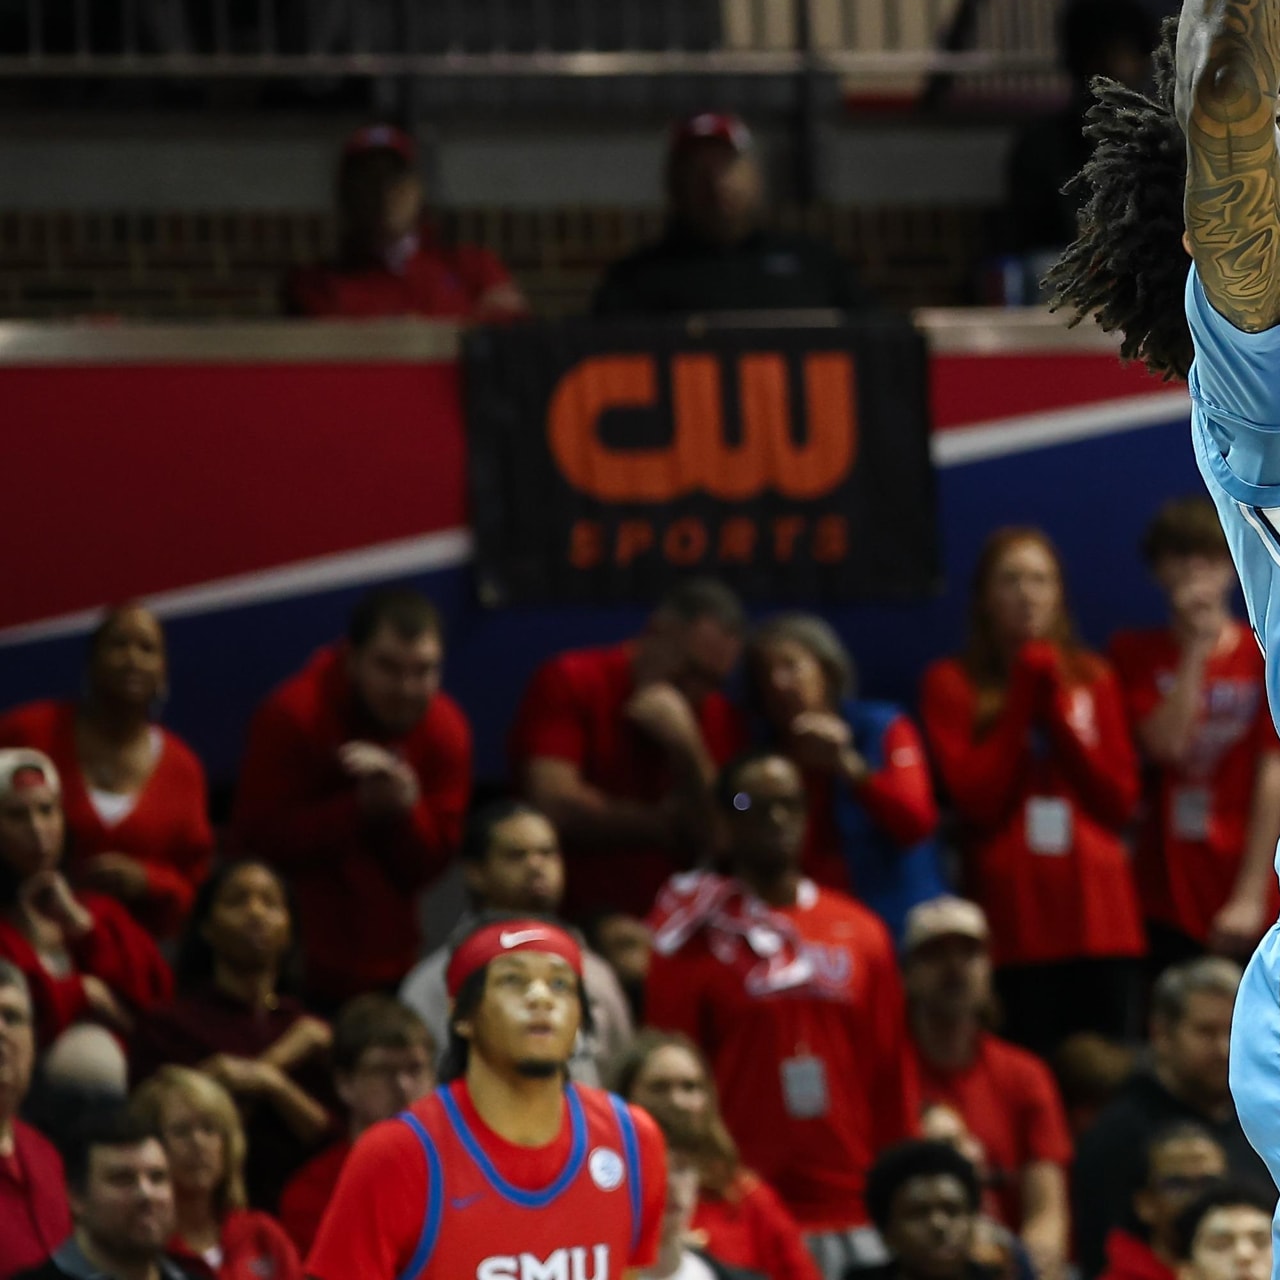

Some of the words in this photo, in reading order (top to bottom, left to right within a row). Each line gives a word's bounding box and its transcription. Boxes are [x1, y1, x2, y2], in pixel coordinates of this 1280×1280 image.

[546, 352, 859, 503] CW
[568, 515, 849, 569] SPORTS
[475, 1243, 610, 1280] SMU
